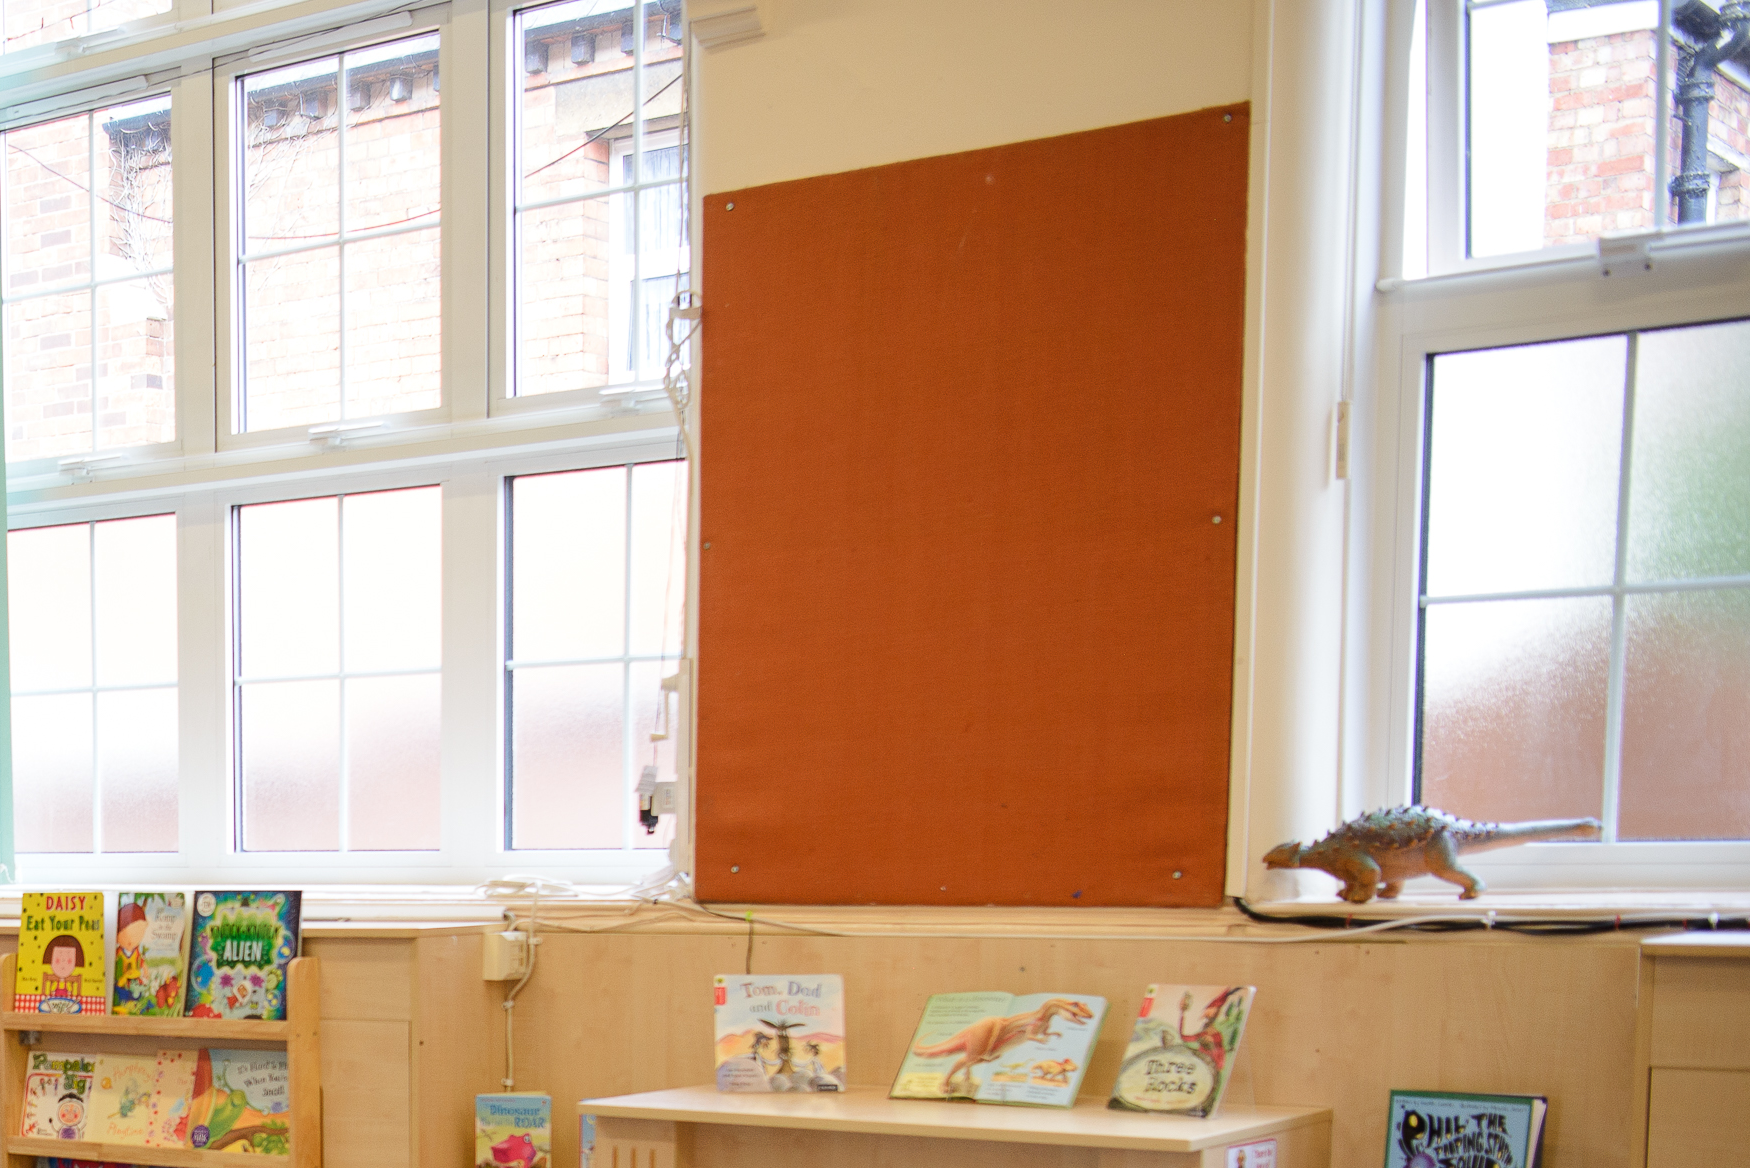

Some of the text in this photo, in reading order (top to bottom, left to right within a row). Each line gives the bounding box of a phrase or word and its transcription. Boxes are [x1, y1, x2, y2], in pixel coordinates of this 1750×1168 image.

[46, 895, 86, 911] DAISY
[26, 915, 100, 931] Eat Your Peas
[223, 940, 263, 962] ALIEN
[787, 981, 822, 999] Dad
[749, 1000, 820, 1017] and Colin
[1144, 1059, 1196, 1077] Three
[1144, 1077, 1197, 1095] Rocks
[490, 1104, 540, 1116] Dinosaur
[514, 1117, 546, 1128] ROAR
[1469, 1113, 1510, 1137] THE
